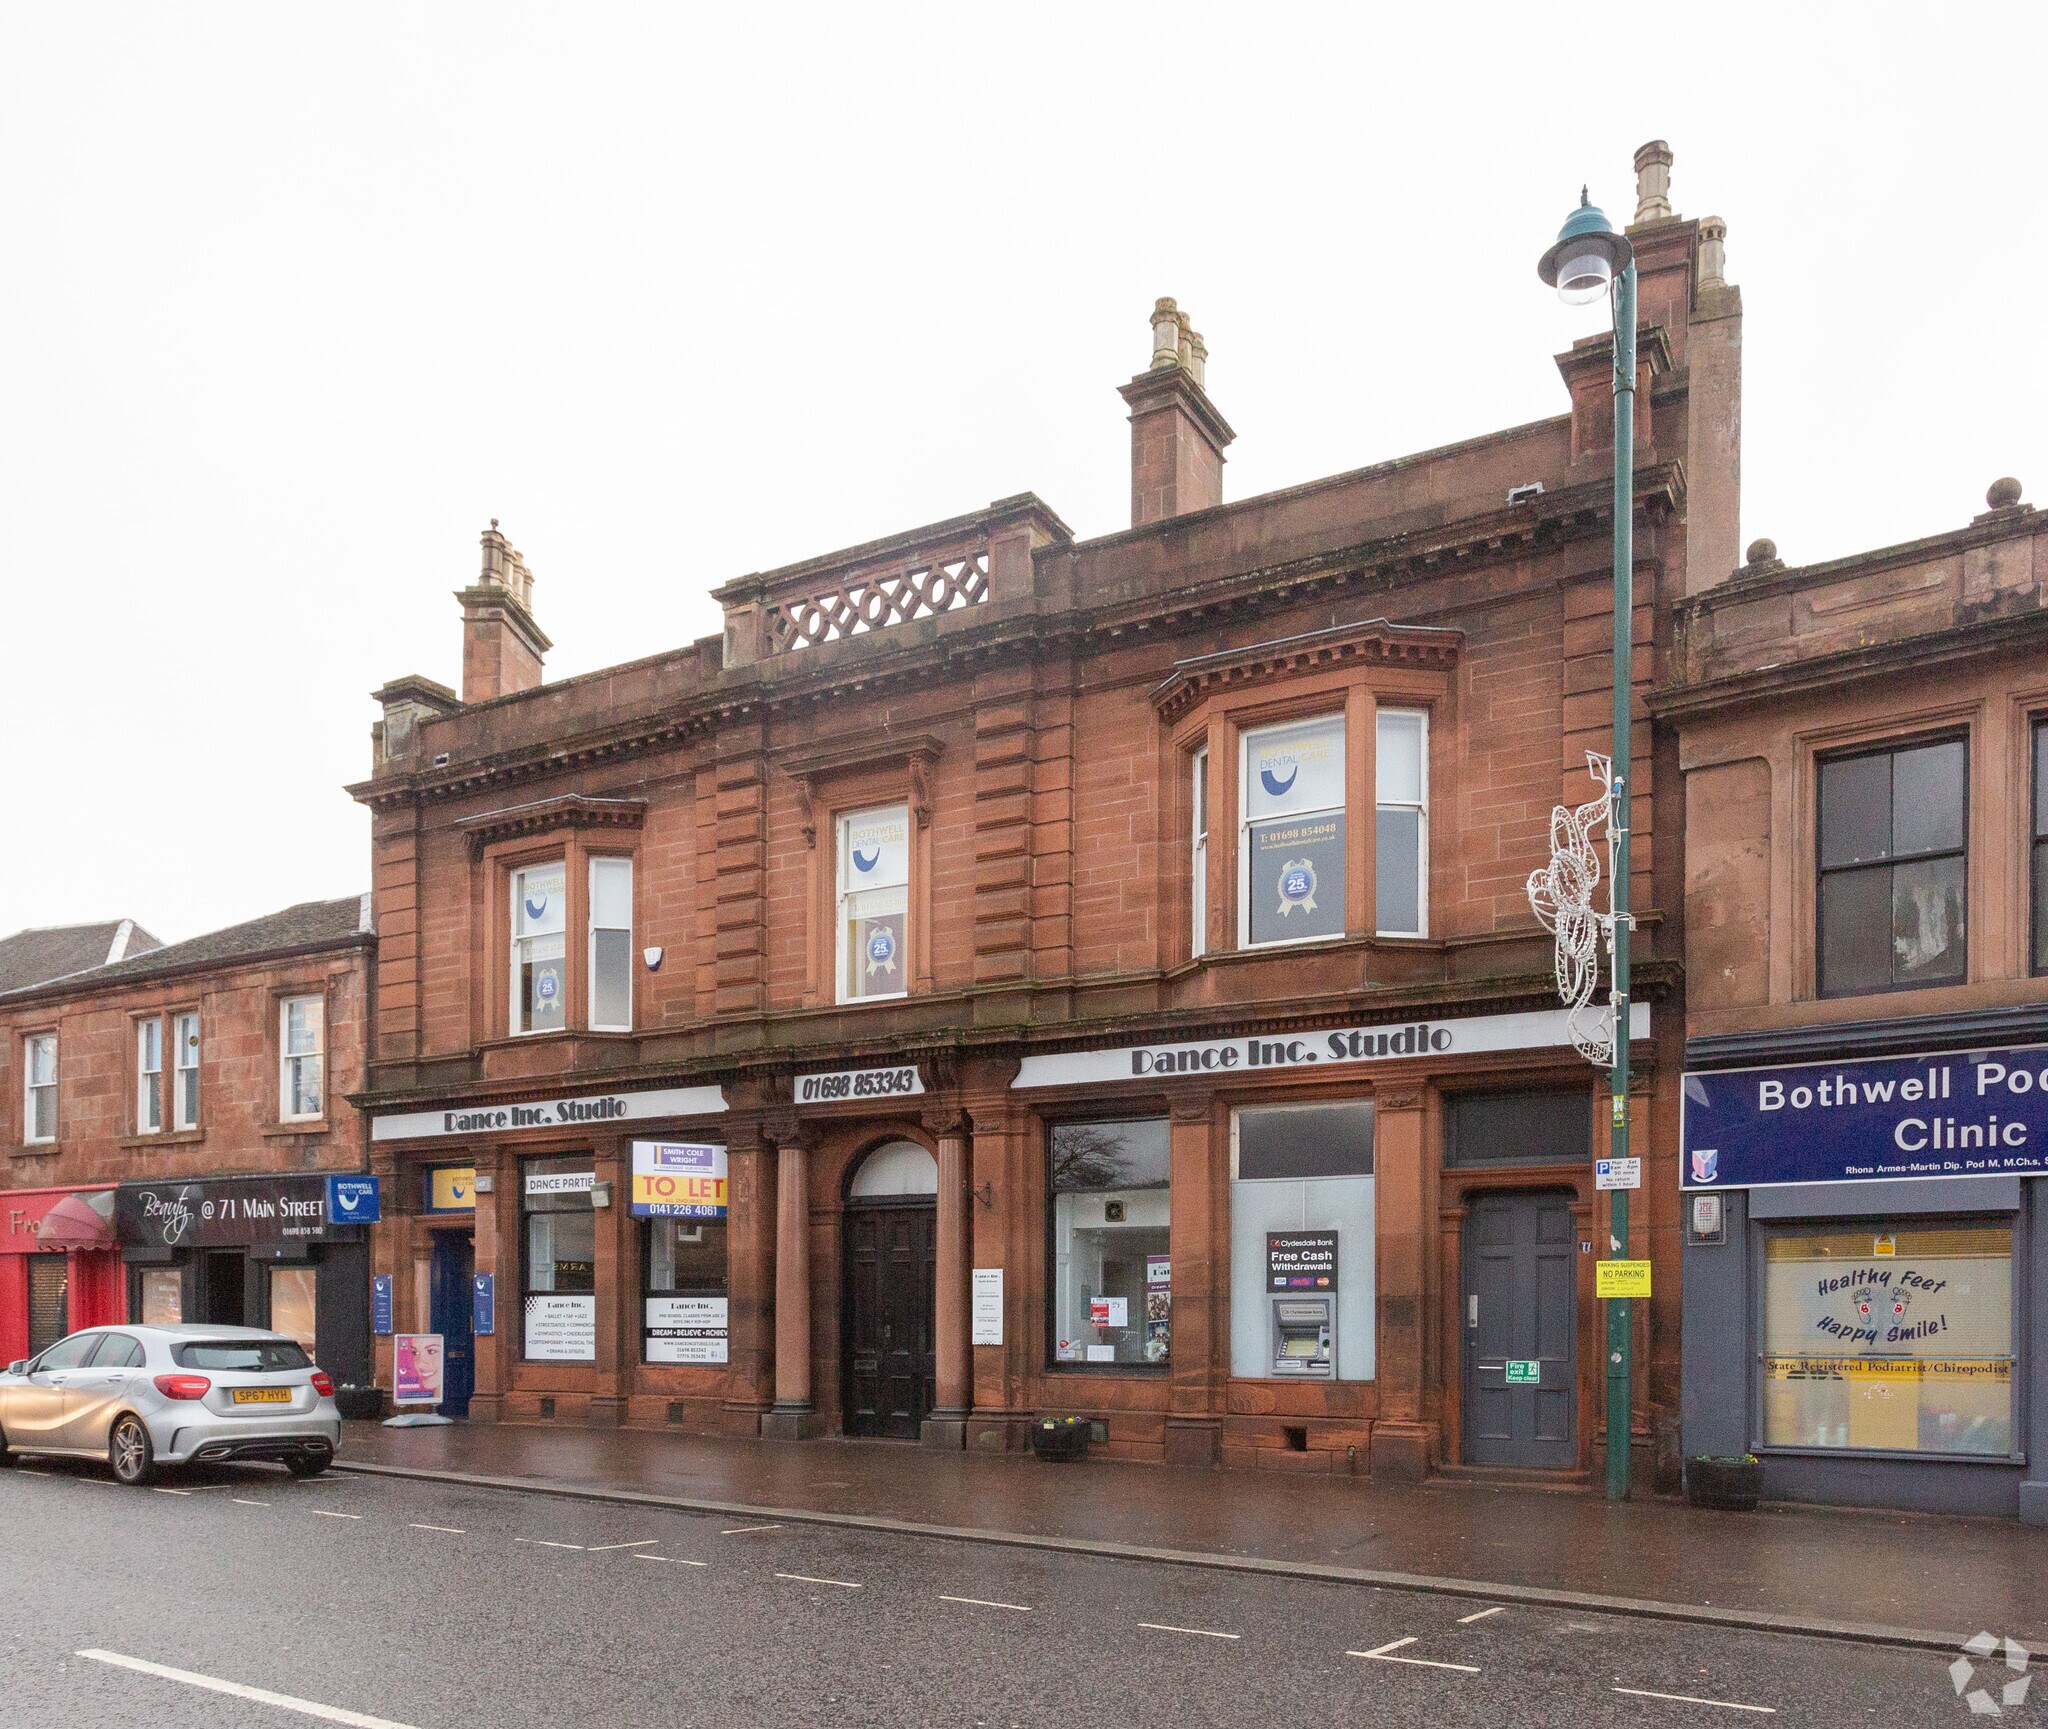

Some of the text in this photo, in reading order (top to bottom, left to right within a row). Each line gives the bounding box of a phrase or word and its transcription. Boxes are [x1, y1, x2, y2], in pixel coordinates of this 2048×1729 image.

[1260, 755, 1297, 769] DENTAL
[852, 825, 904, 840] BOTHWELL
[1270, 828, 1298, 842] 01698
[1301, 823, 1337, 837] 854048
[852, 832, 904, 849] DENTAL CARE
[1287, 878, 1305, 891] 25
[873, 944, 886, 954] 25
[542, 983, 553, 993] 25
[1131, 1024, 1453, 1076] Dance Inc. Studio
[802, 1069, 914, 1100] 01698 853343
[1758, 1066, 1950, 1112] Bothwell
[444, 1096, 627, 1132] Dance Inc. Studio
[1894, 1115, 2028, 1152] Clinic
[669, 1156, 698, 1164] WRIGHT
[1845, 1166, 1874, 1175] Rhona
[1876, 1162, 1941, 1173] Armes-Martin
[1943, 1161, 1963, 1171] Dip.
[1966, 1159, 1985, 1169] Pod
[337, 1182, 372, 1190] BOTHWELL
[530, 1177, 594, 1190] DANCE PARTIE
[643, 1176, 724, 1198] TO LET
[138, 1185, 194, 1245] Beauty
[201, 1201, 215, 1220] @
[219, 1199, 236, 1220] 71
[649, 1203, 718, 1216] 0141 226 4061
[1280, 1240, 1316, 1248] Clydesdale
[1271, 1251, 1333, 1261] Free Cash
[1271, 1262, 1333, 1271] Withdrawals
[1602, 1269, 1645, 1278] NO PARKING
[1818, 1267, 1947, 1297] Healthy Feet
[651, 1328, 728, 1337] DREAM BELIEVE ACHIEV
[1817, 1314, 1948, 1346] Happy Smile!
[1768, 1361, 2009, 1374] State Registered Podiatrist/Chiropodist
[239, 1391, 265, 1401] SP67
